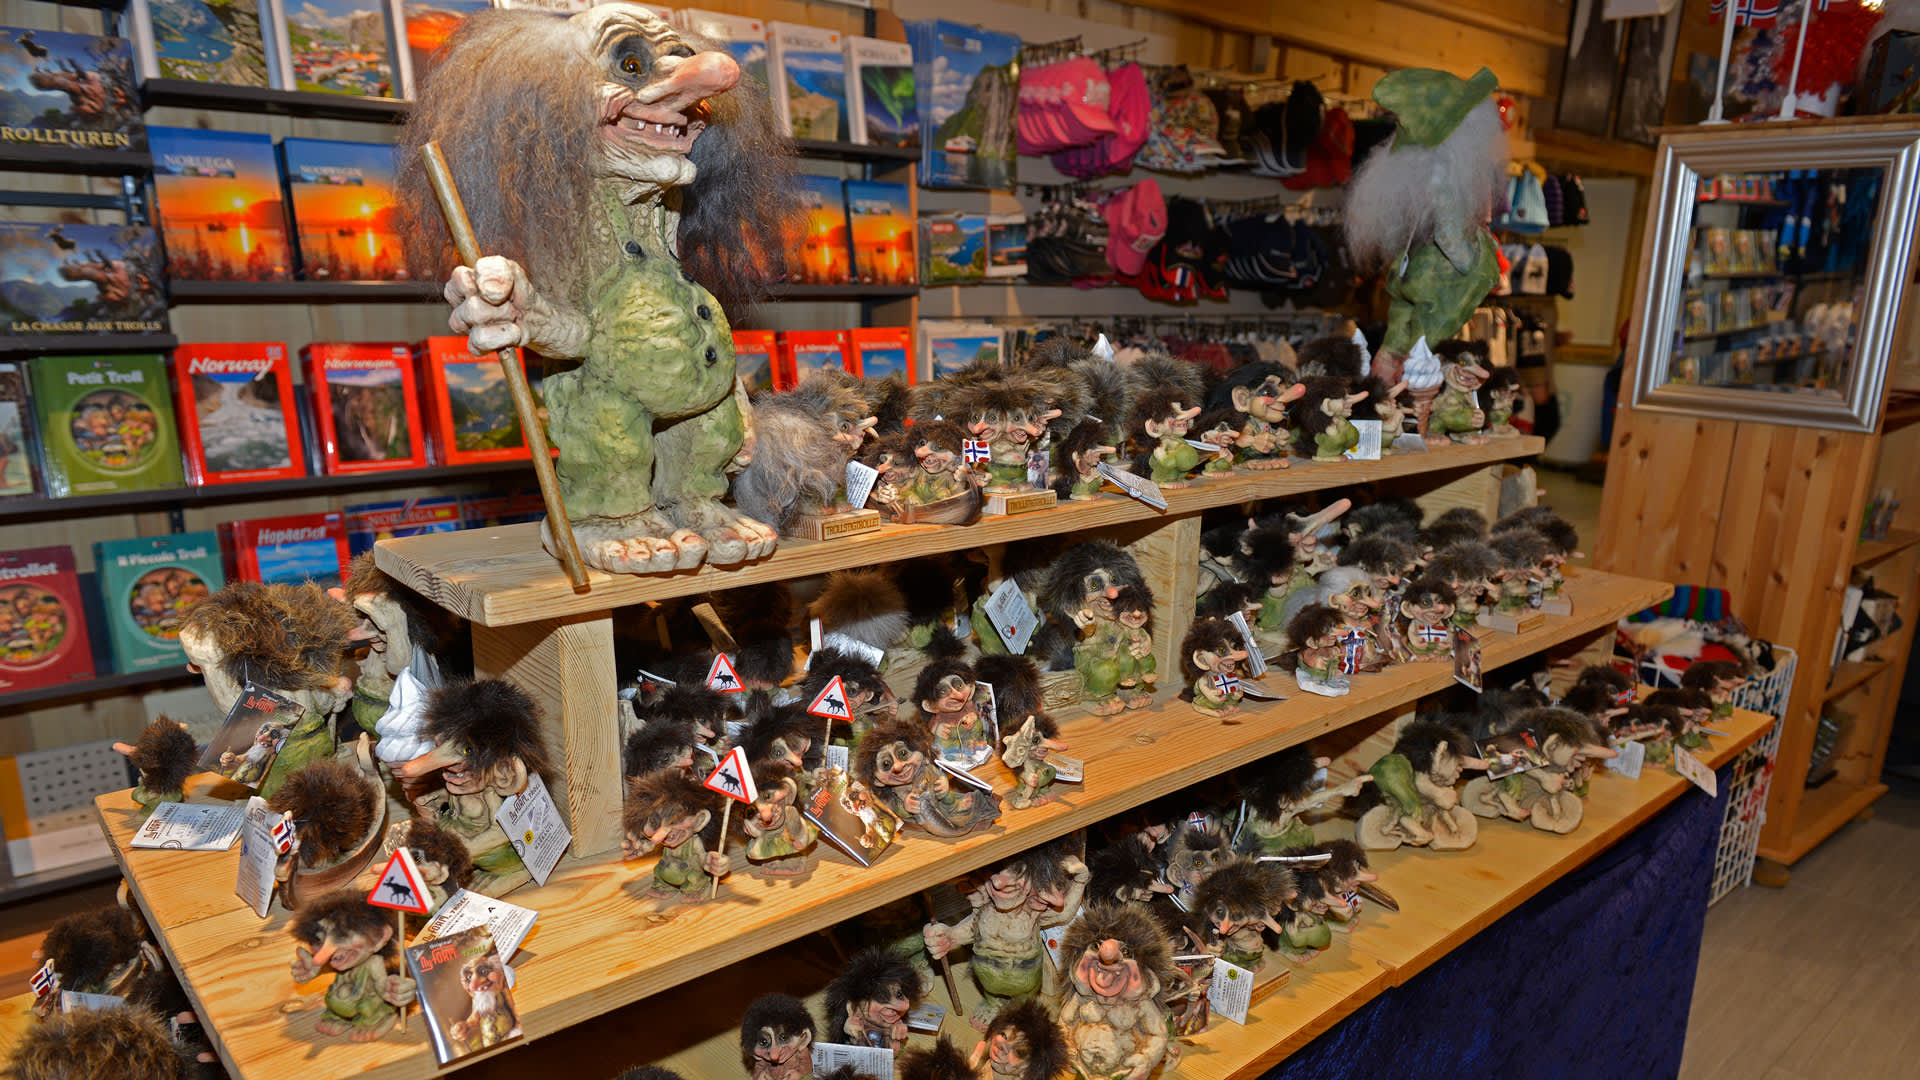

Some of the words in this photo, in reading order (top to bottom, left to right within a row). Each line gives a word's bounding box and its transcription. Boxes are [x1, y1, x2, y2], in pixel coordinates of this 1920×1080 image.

[0, 126, 131, 147] ROLLTUREN
[115, 321, 162, 332] TROLLS
[66, 371, 104, 385] Petit
[106, 370, 144, 384] Troll
[188, 357, 274, 381] Norway
